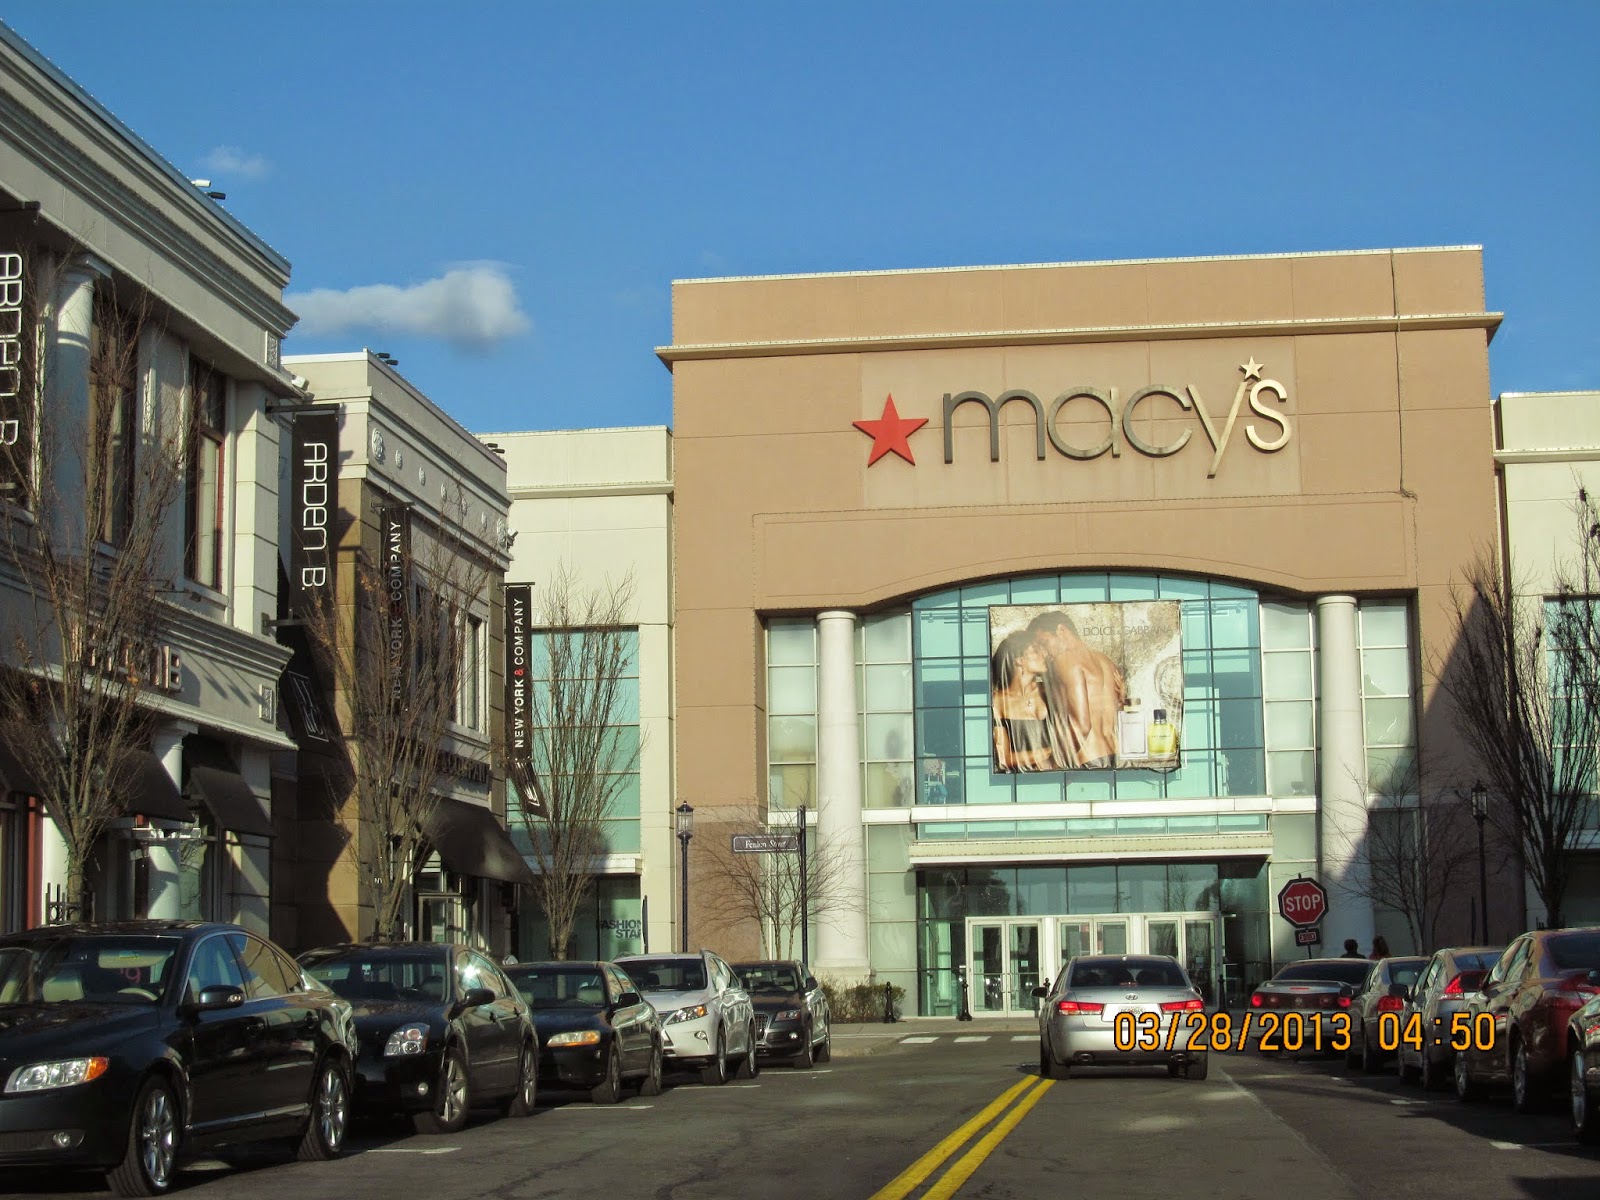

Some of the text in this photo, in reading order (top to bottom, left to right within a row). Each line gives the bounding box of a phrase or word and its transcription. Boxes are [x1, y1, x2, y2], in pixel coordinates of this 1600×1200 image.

[942, 356, 1293, 480] macy's
[390, 521, 402, 602] COMPANY
[1083, 626, 1116, 637] DOLCE
[1123, 625, 1172, 636] GABBANA
[514, 598, 524, 748] NEW YORK & COMPANY
[1285, 893, 1321, 912] STOP
